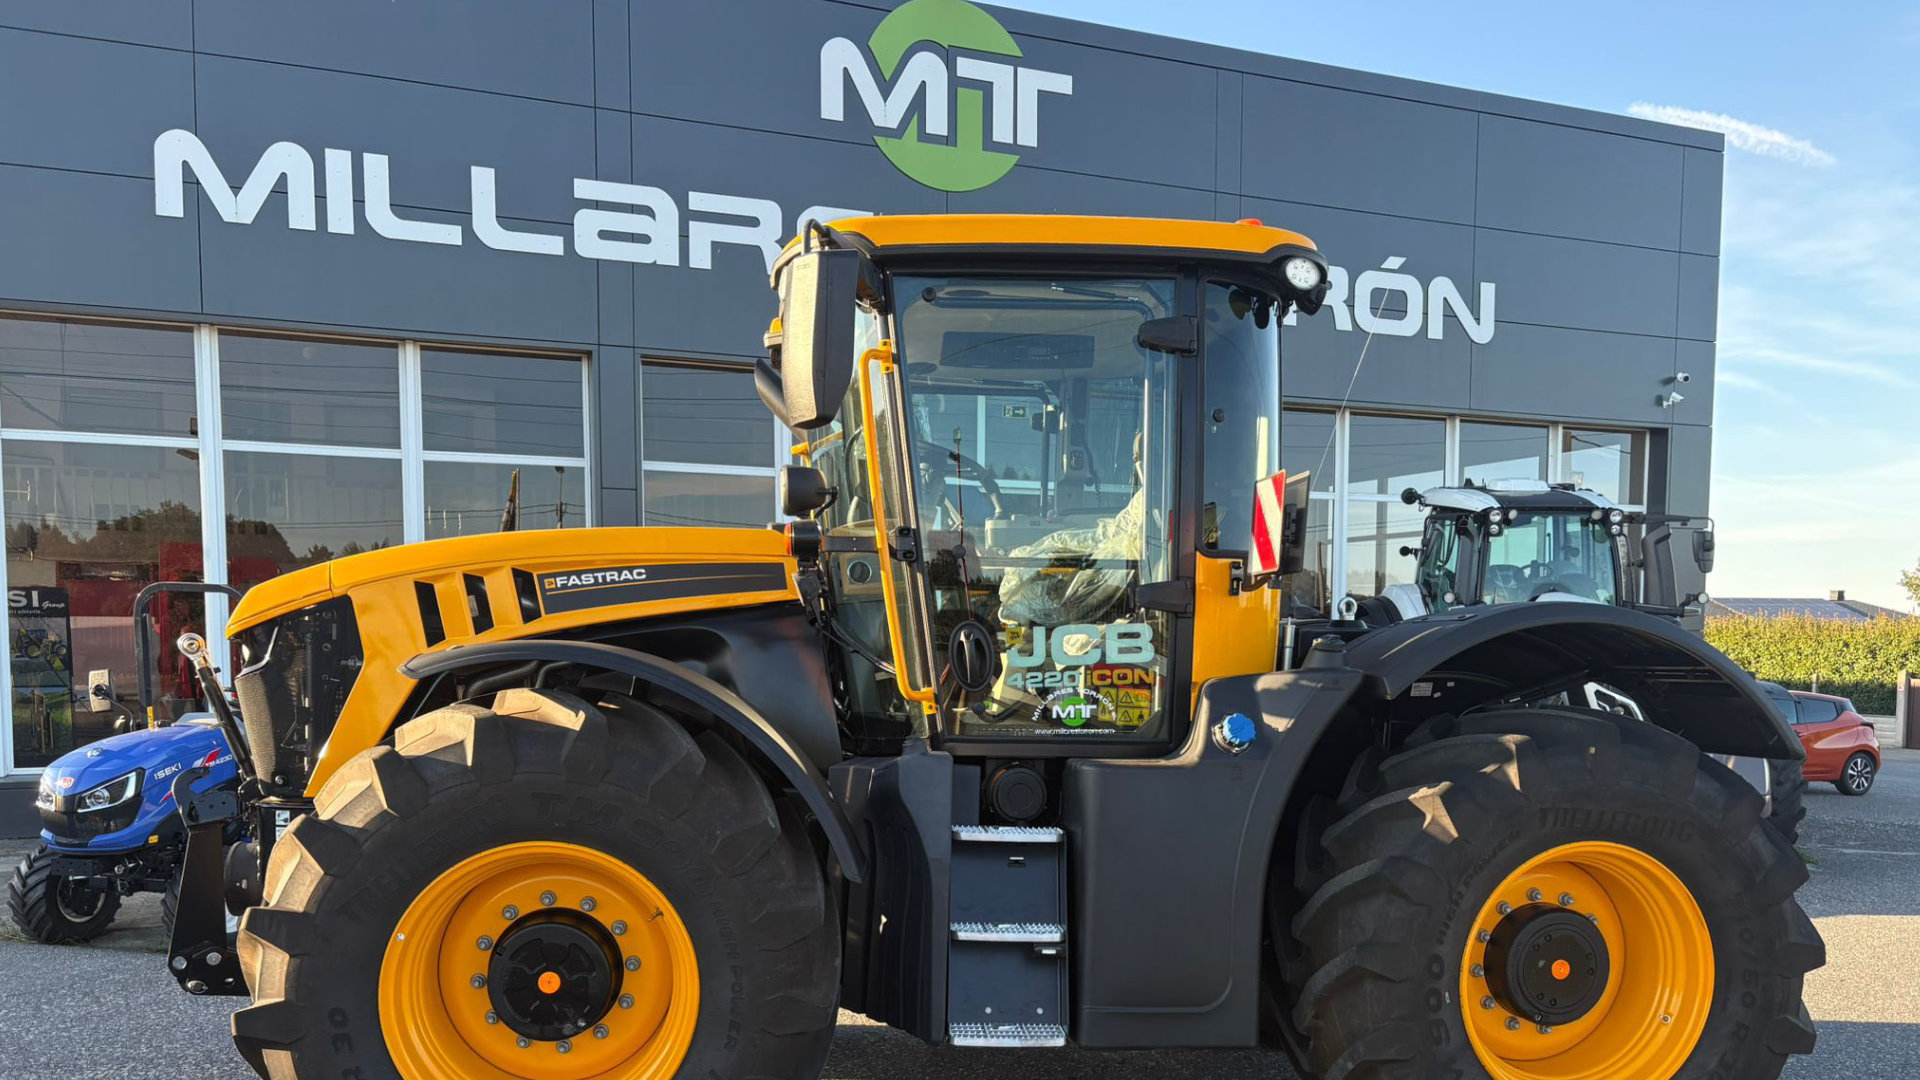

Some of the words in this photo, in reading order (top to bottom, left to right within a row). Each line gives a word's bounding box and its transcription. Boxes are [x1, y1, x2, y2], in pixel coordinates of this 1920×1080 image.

[154, 128, 873, 275] MILLaR
[556, 568, 647, 588] FASTRAC
[1006, 623, 1155, 667] JCB
[1006, 670, 1080, 689] 4220
[1087, 668, 1155, 686] iCON
[154, 762, 182, 780] ISEKI
